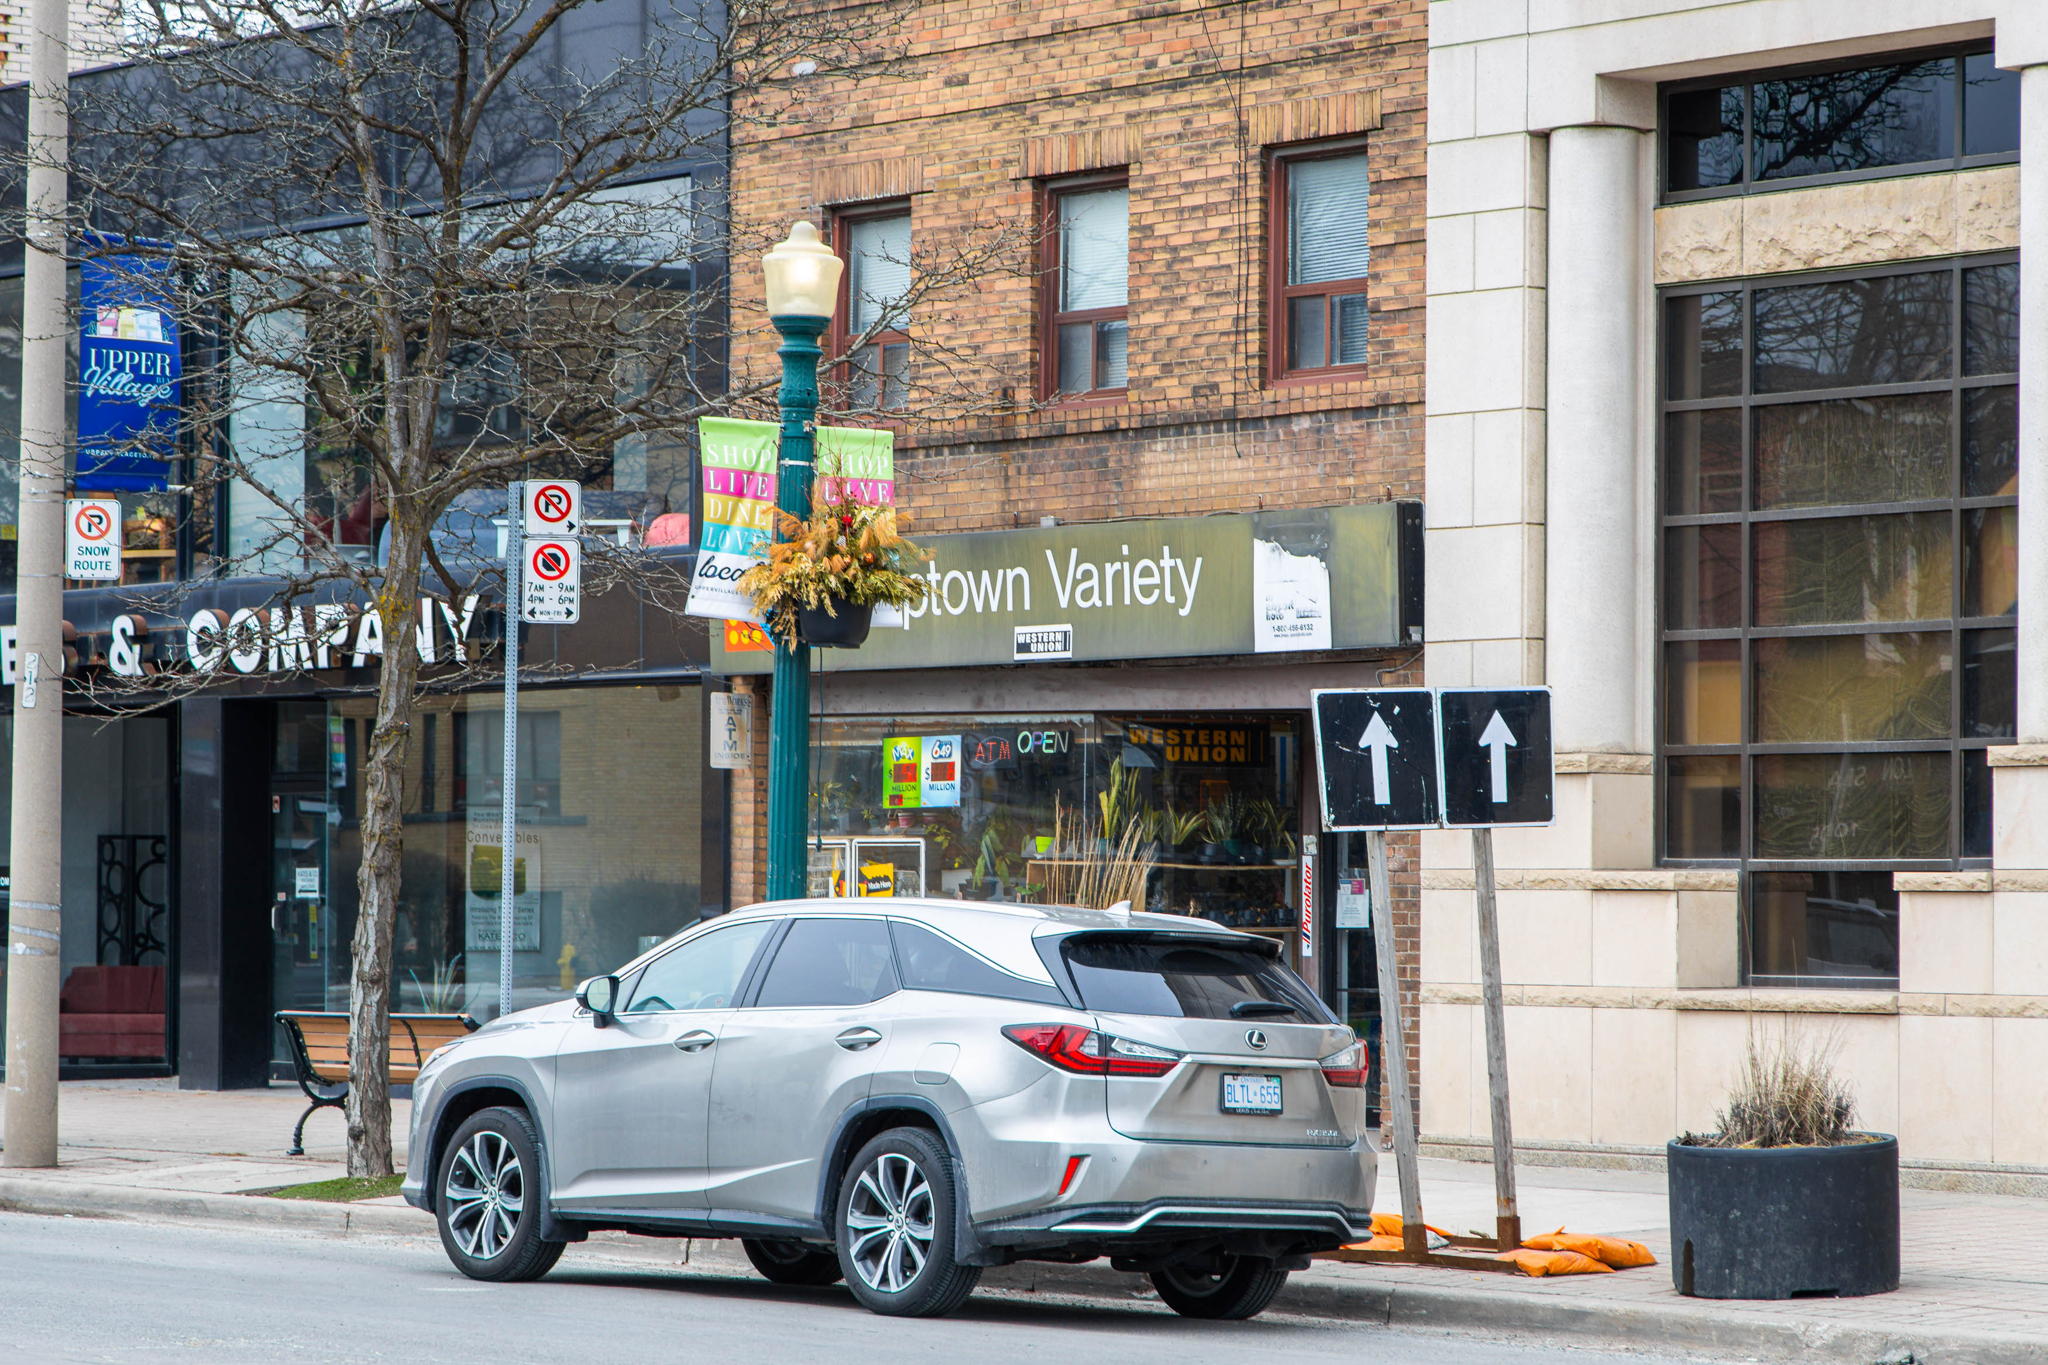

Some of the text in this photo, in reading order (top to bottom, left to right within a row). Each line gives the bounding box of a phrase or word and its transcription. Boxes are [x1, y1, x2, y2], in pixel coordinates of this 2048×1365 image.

[90, 348, 172, 377] UPPER
[83, 366, 174, 408] Village
[705, 443, 772, 469] SHOP
[822, 455, 889, 476] SHOP
[707, 469, 769, 498] LIVE
[824, 481, 890, 504] LIVE
[709, 498, 768, 527] DINE
[77, 545, 110, 557] SNOW
[74, 560, 113, 571] ROUTE
[698, 555, 765, 582] loca
[527, 581, 545, 592] 7AM
[557, 582, 575, 593] 9AM
[903, 544, 1202, 631] ptown Variety
[527, 593, 545, 604] 4PM
[558, 594, 575, 605] 6PM
[109, 615, 144, 677] &
[186, 594, 480, 674] COMPANY
[1017, 631, 1062, 644] WESTERN
[1030, 641, 1062, 653] UNION
[1017, 730, 1069, 754] OPEN
[1129, 728, 1246, 745] WESTERN
[975, 742, 1011, 761] ATM
[1165, 745, 1246, 762] UNION
[892, 783, 917, 793] MILLION
[929, 782, 956, 791] MILLION
[467, 830, 539, 844] Convebles
[1302, 863, 1312, 934] Purolator
[1226, 1083, 1280, 1105] BLTL 655
